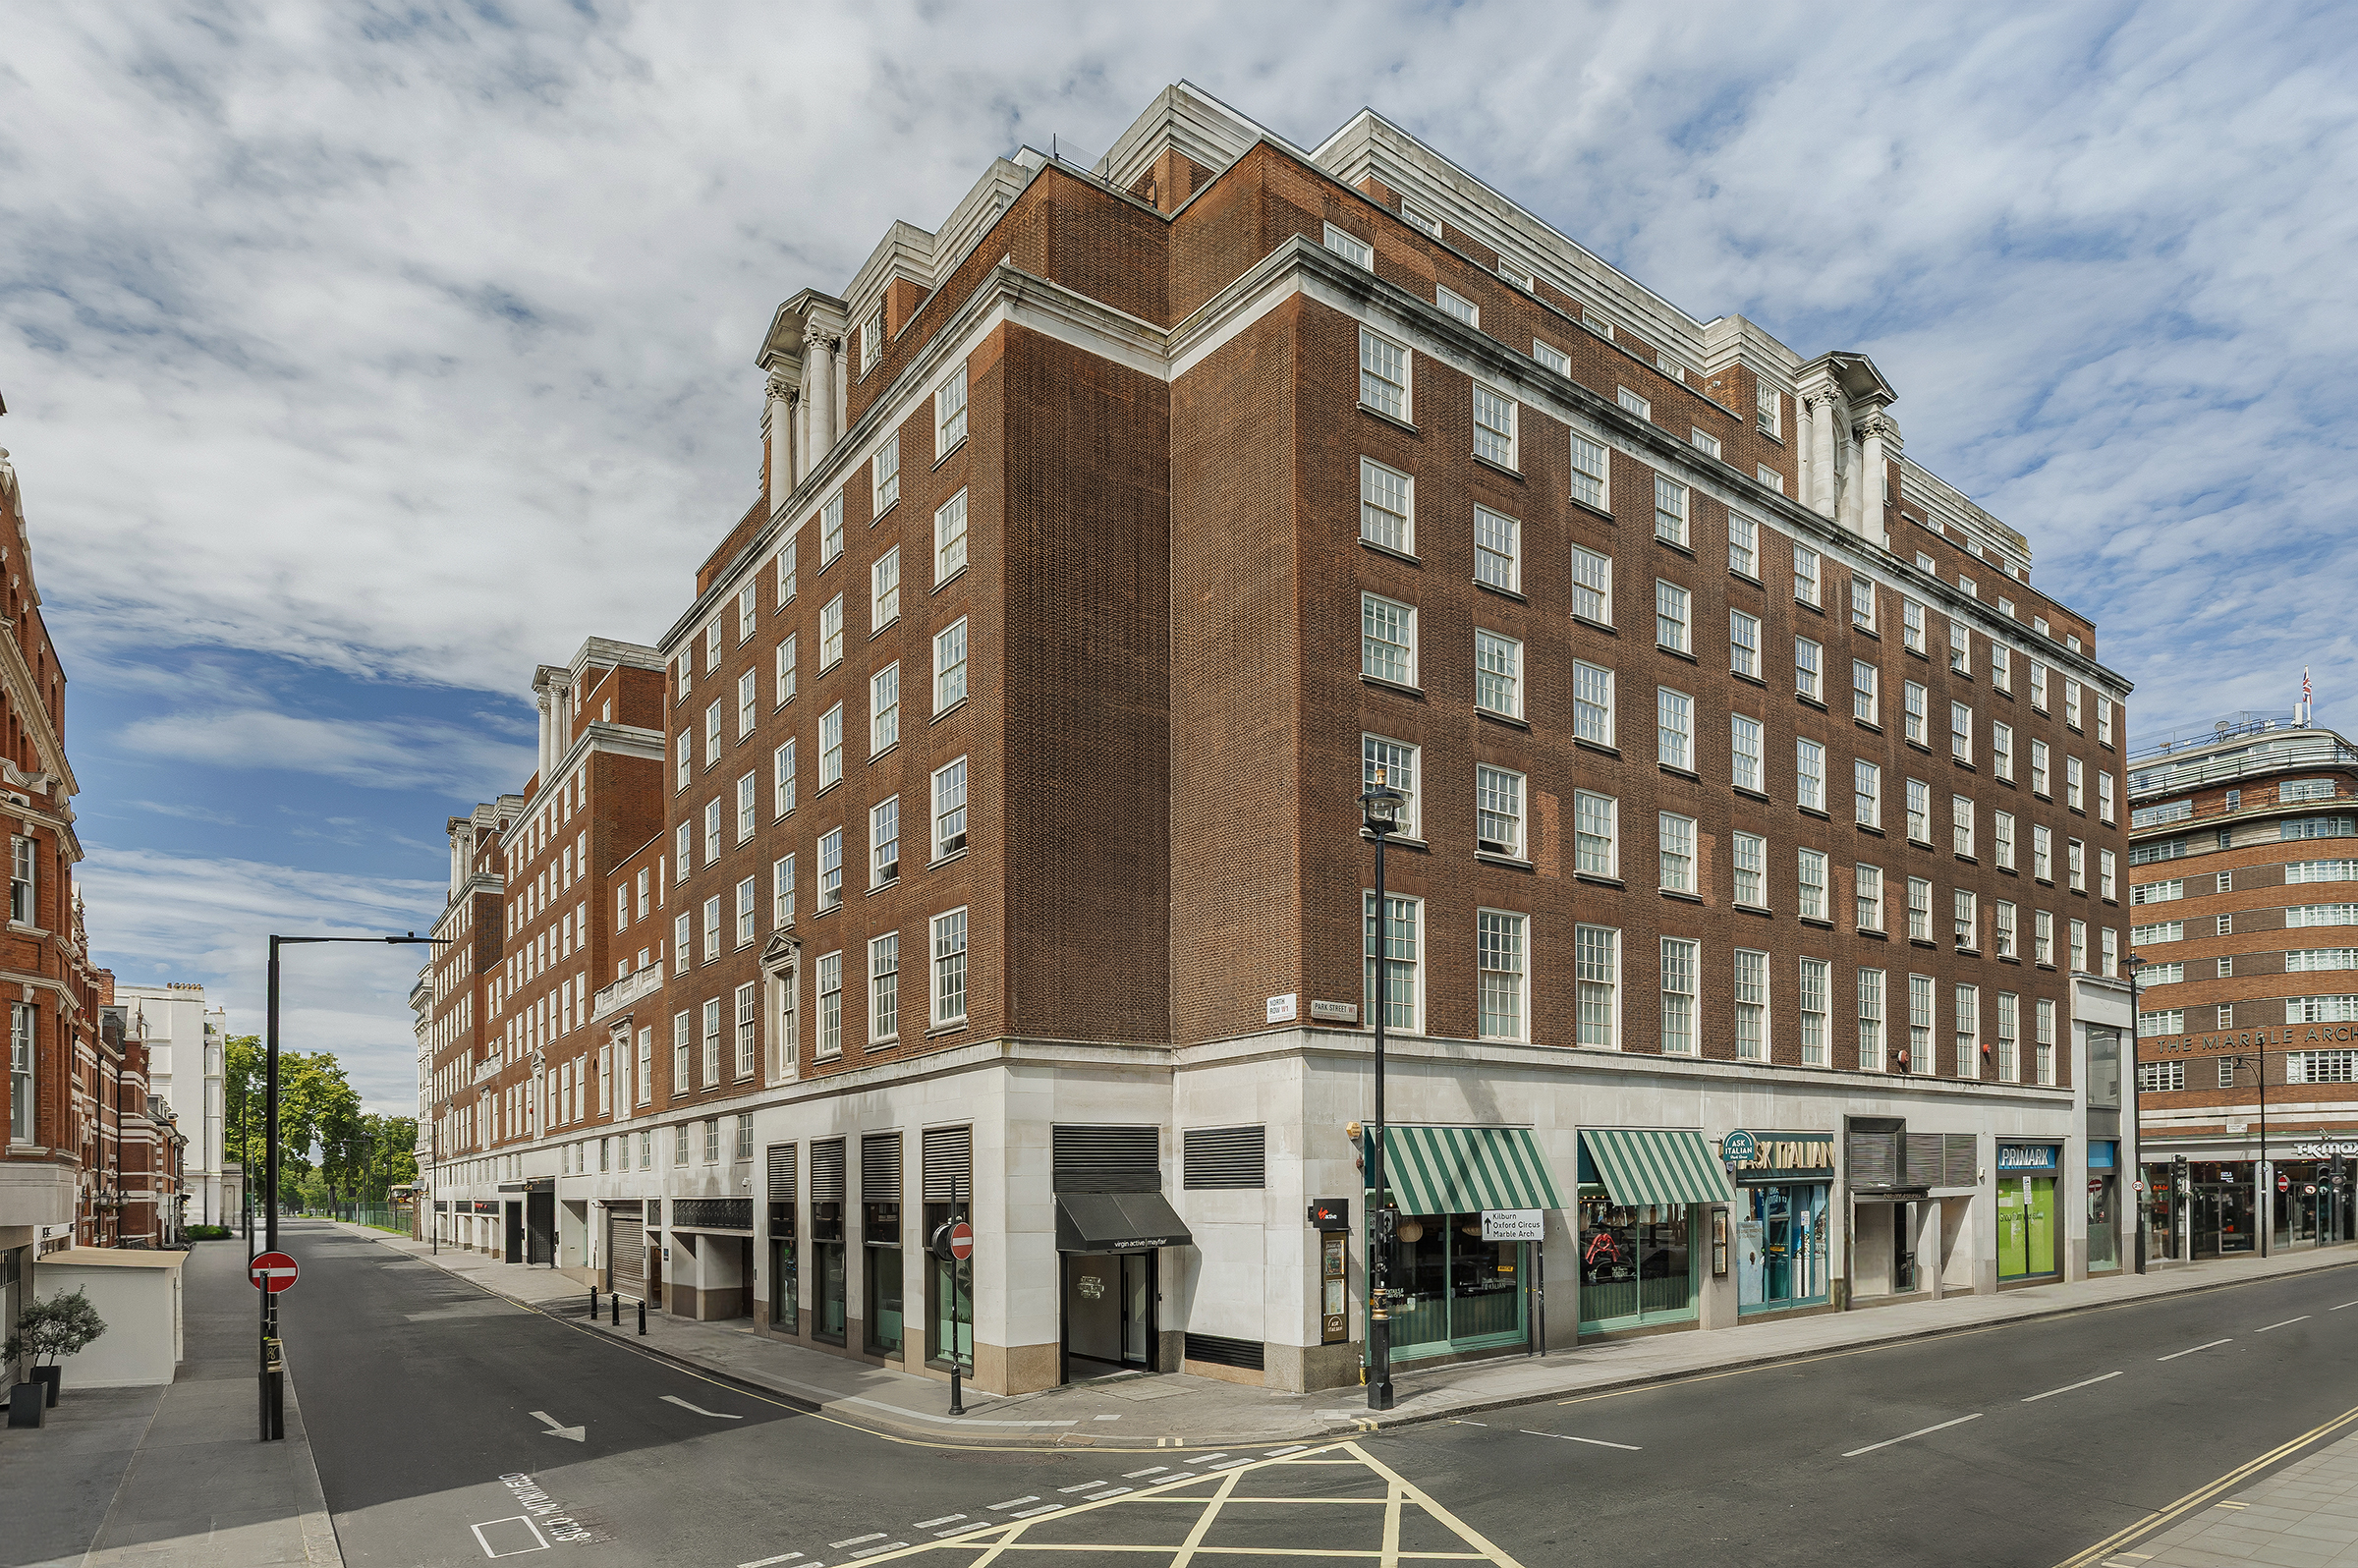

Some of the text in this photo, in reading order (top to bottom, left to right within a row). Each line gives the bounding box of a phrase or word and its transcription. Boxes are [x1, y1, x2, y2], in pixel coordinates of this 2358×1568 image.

[1315, 1002, 1328, 1011] PARK
[1328, 1004, 1347, 1013] STREET
[2158, 1037, 2192, 1054] THE
[2202, 1030, 2293, 1050] MARBLE
[1775, 1141, 1834, 1169] ITALIAN
[2000, 1148, 2049, 1165] PRIMARK
[1114, 1240, 1130, 1249] virgin
